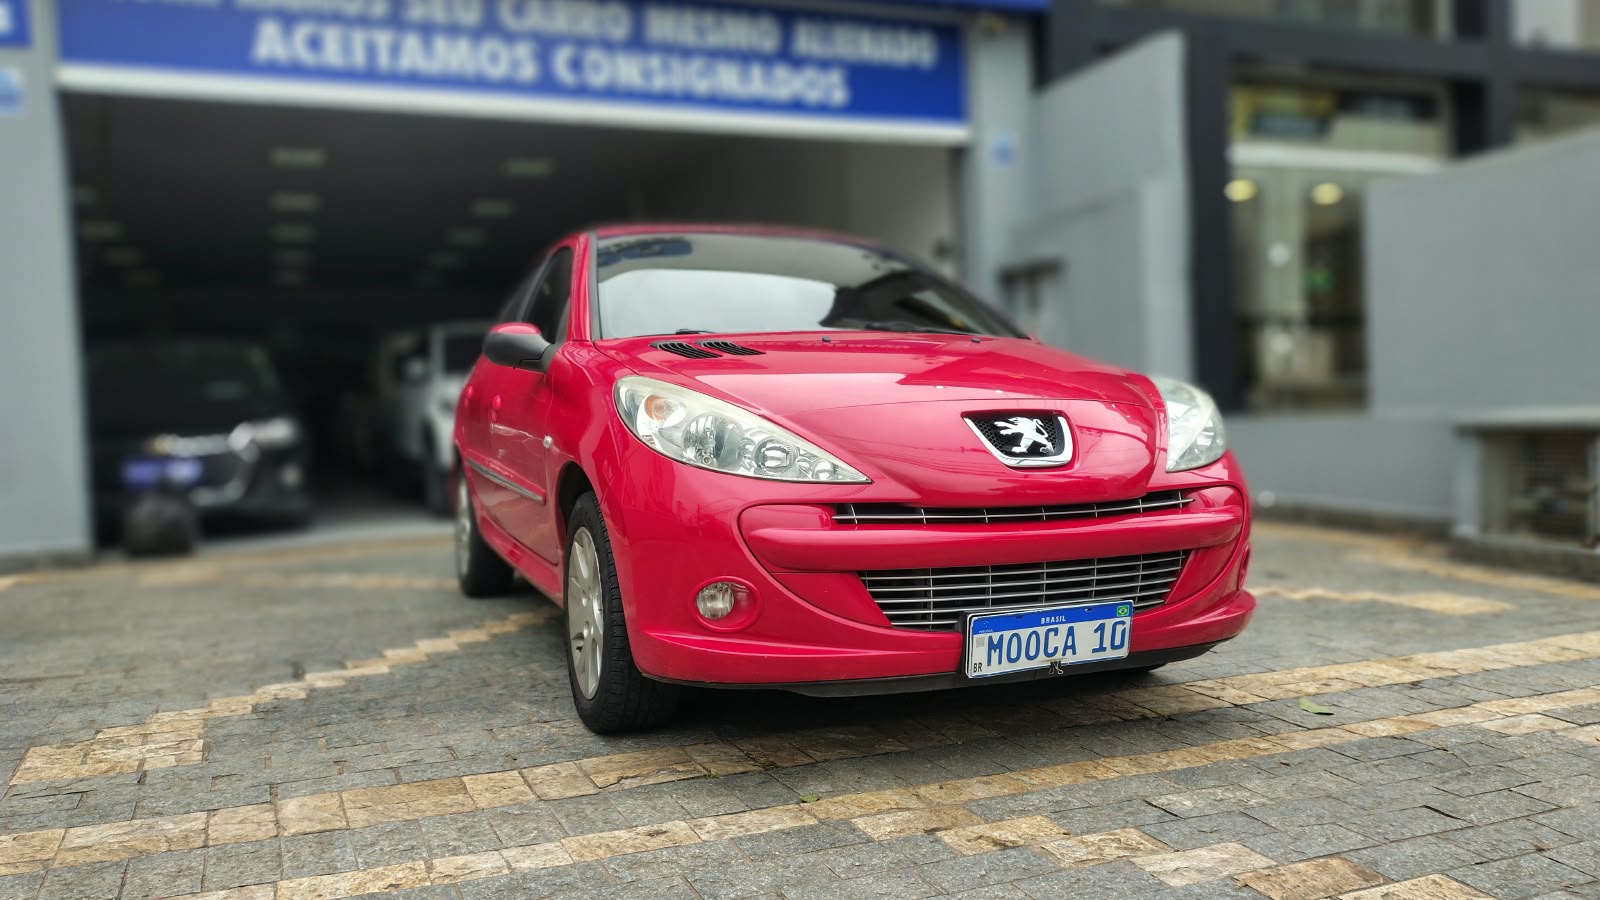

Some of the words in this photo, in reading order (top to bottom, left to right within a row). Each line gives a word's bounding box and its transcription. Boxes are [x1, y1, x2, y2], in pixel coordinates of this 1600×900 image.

[500, 0, 633, 42] CARRO
[645, 8, 781, 54] MESMO
[792, 19, 938, 69] ALIENADO
[251, 18, 539, 84] ACEITAMOS
[553, 44, 849, 108] CONSIGNADOS
[986, 625, 1077, 667] MOOCA
[1091, 619, 1127, 654] 10
[1040, 615, 1067, 625] BRASIL
[973, 662, 983, 673] BR
